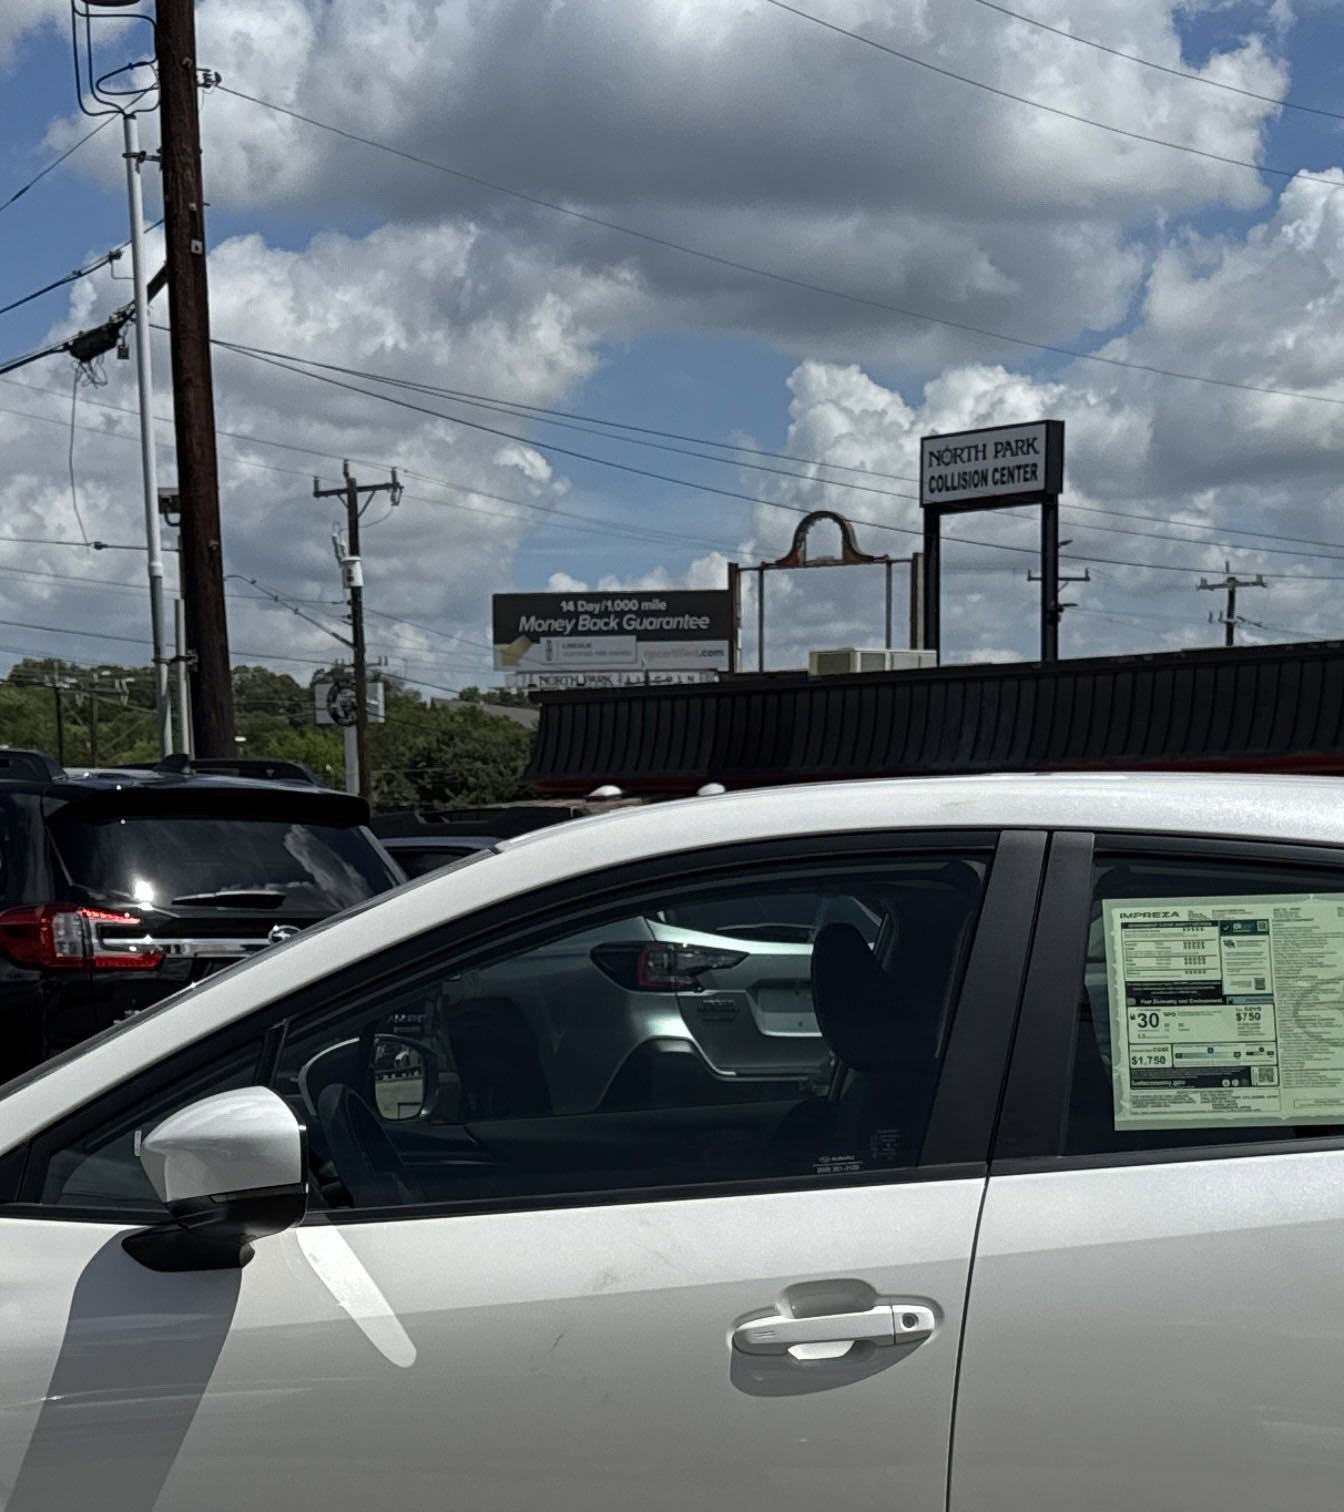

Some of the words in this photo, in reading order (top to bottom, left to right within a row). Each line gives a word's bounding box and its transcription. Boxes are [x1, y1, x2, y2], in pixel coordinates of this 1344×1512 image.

[928, 443, 987, 468] NORTH
[993, 437, 1040, 459] PARK
[928, 468, 988, 494] COLLISION
[992, 463, 1039, 486] CENTER
[560, 601, 575, 612] 14
[641, 599, 667, 611] mile
[519, 615, 576, 635] Money
[578, 614, 619, 631] Back
[622, 614, 711, 631] Guarantee
[1120, 911, 1180, 919] IMPREZA
[1137, 1012, 1160, 1028] 30
